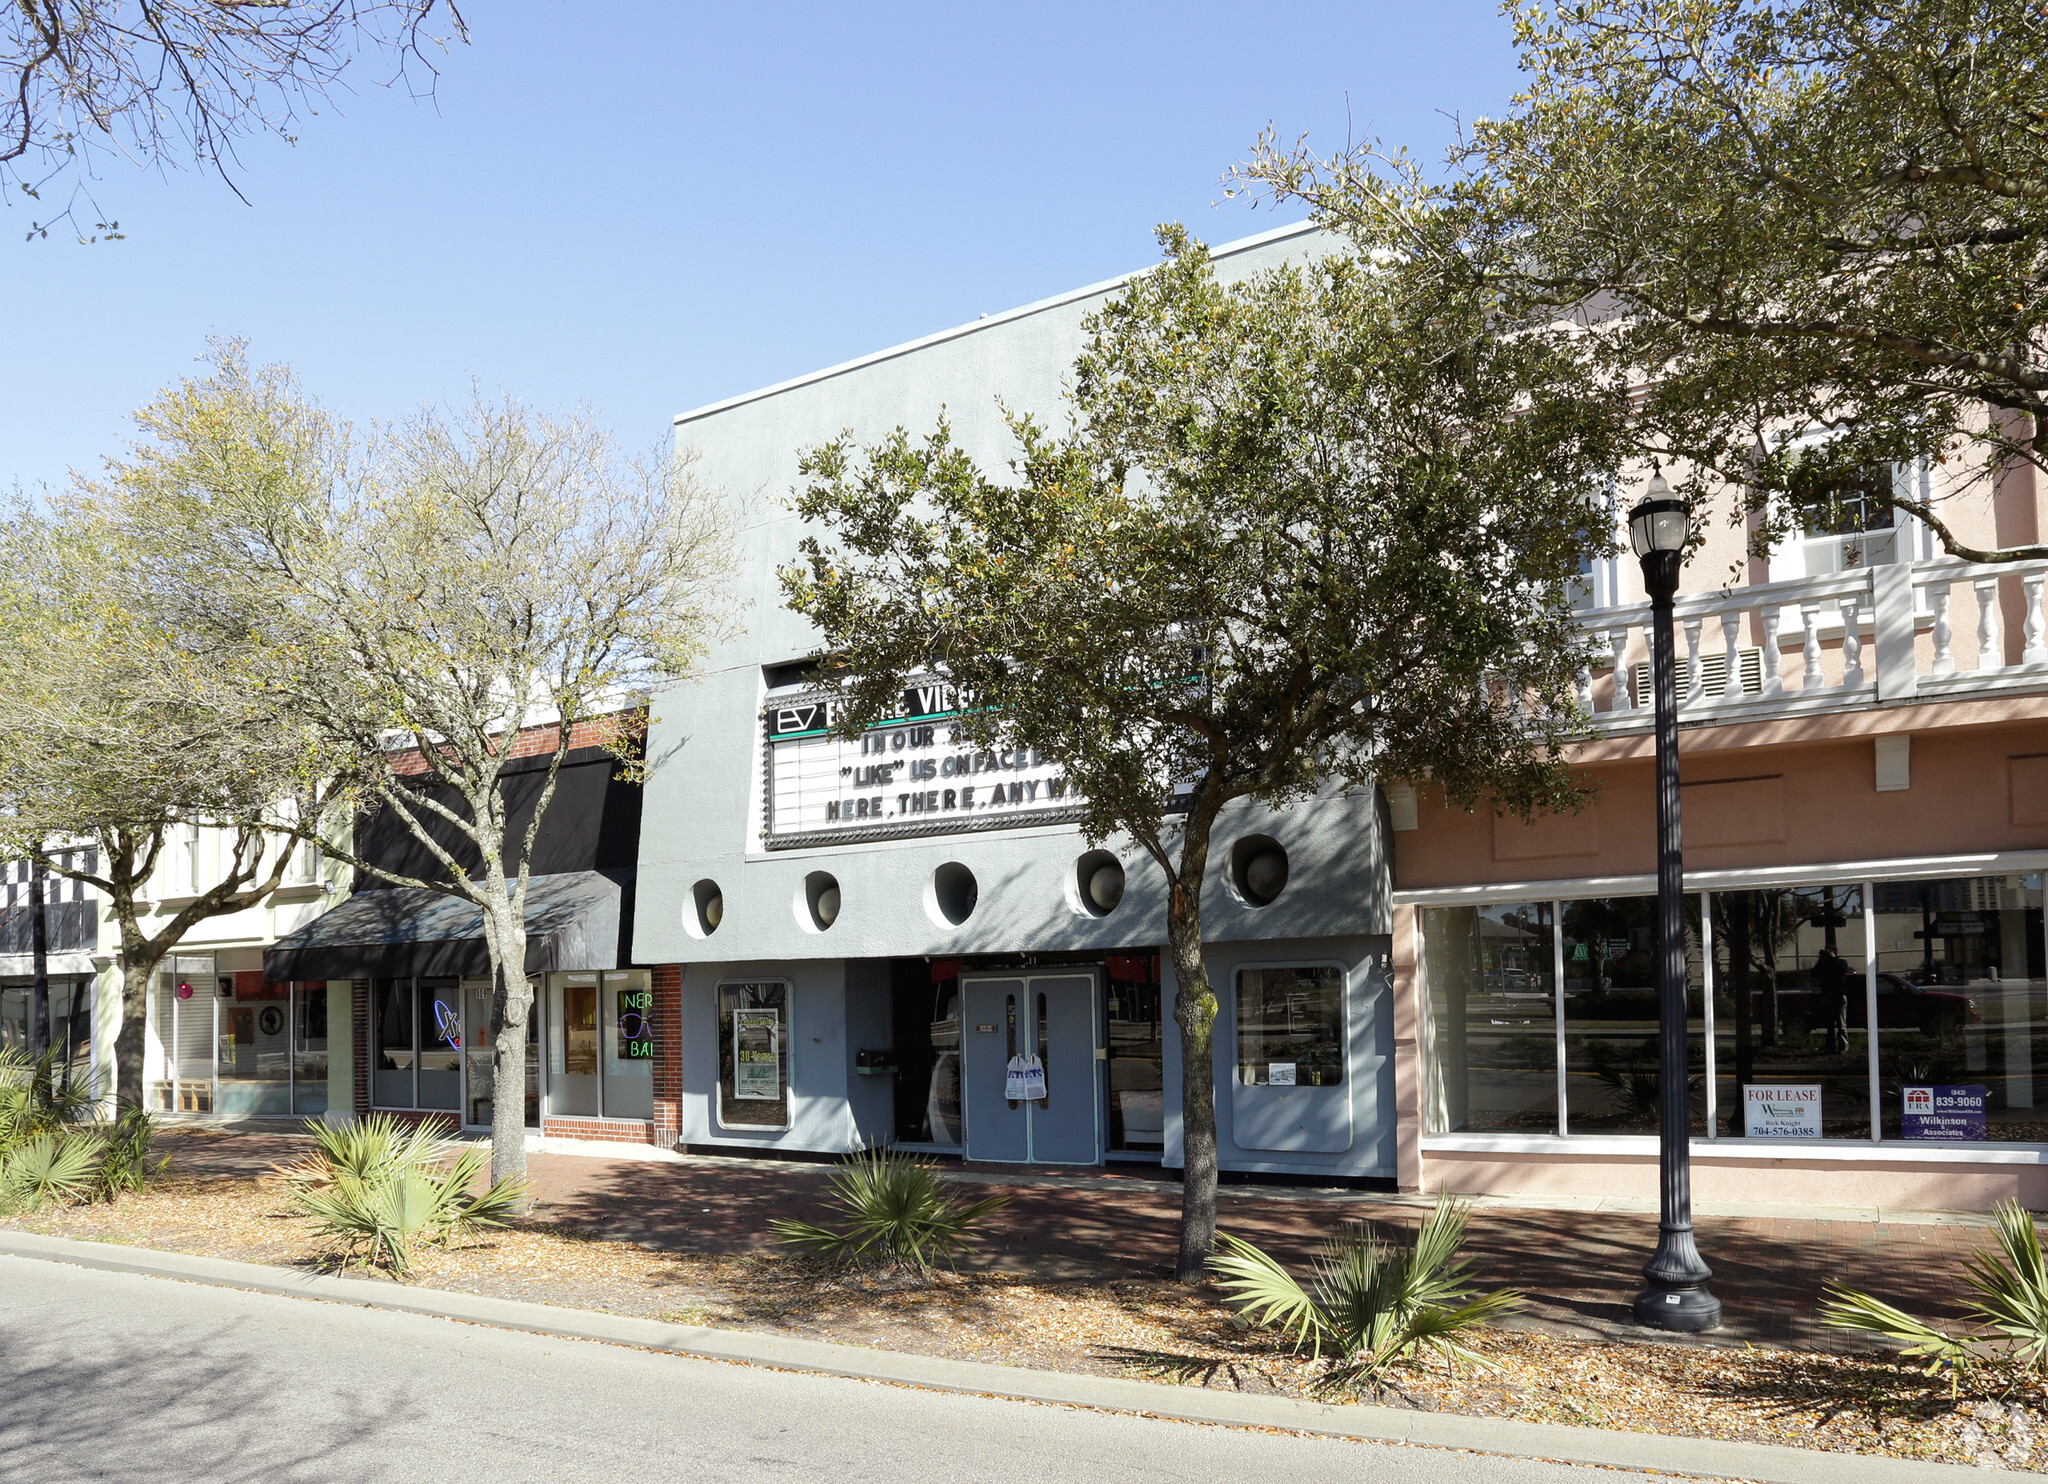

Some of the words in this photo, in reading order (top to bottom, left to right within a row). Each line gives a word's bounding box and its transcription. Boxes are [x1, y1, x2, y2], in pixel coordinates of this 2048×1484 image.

[893, 726, 934, 749] OUR
[910, 758, 937, 781] US
[625, 992, 653, 1009] NER
[740, 1051, 751, 1062] 30
[1748, 1090, 1774, 1101] FOR
[1777, 1090, 1817, 1101] LEASE
[1936, 1096, 1982, 1107] 839-9060
[1920, 1116, 1967, 1125] Wilkinson
[1753, 1127, 1814, 1136] 704-576-0385
